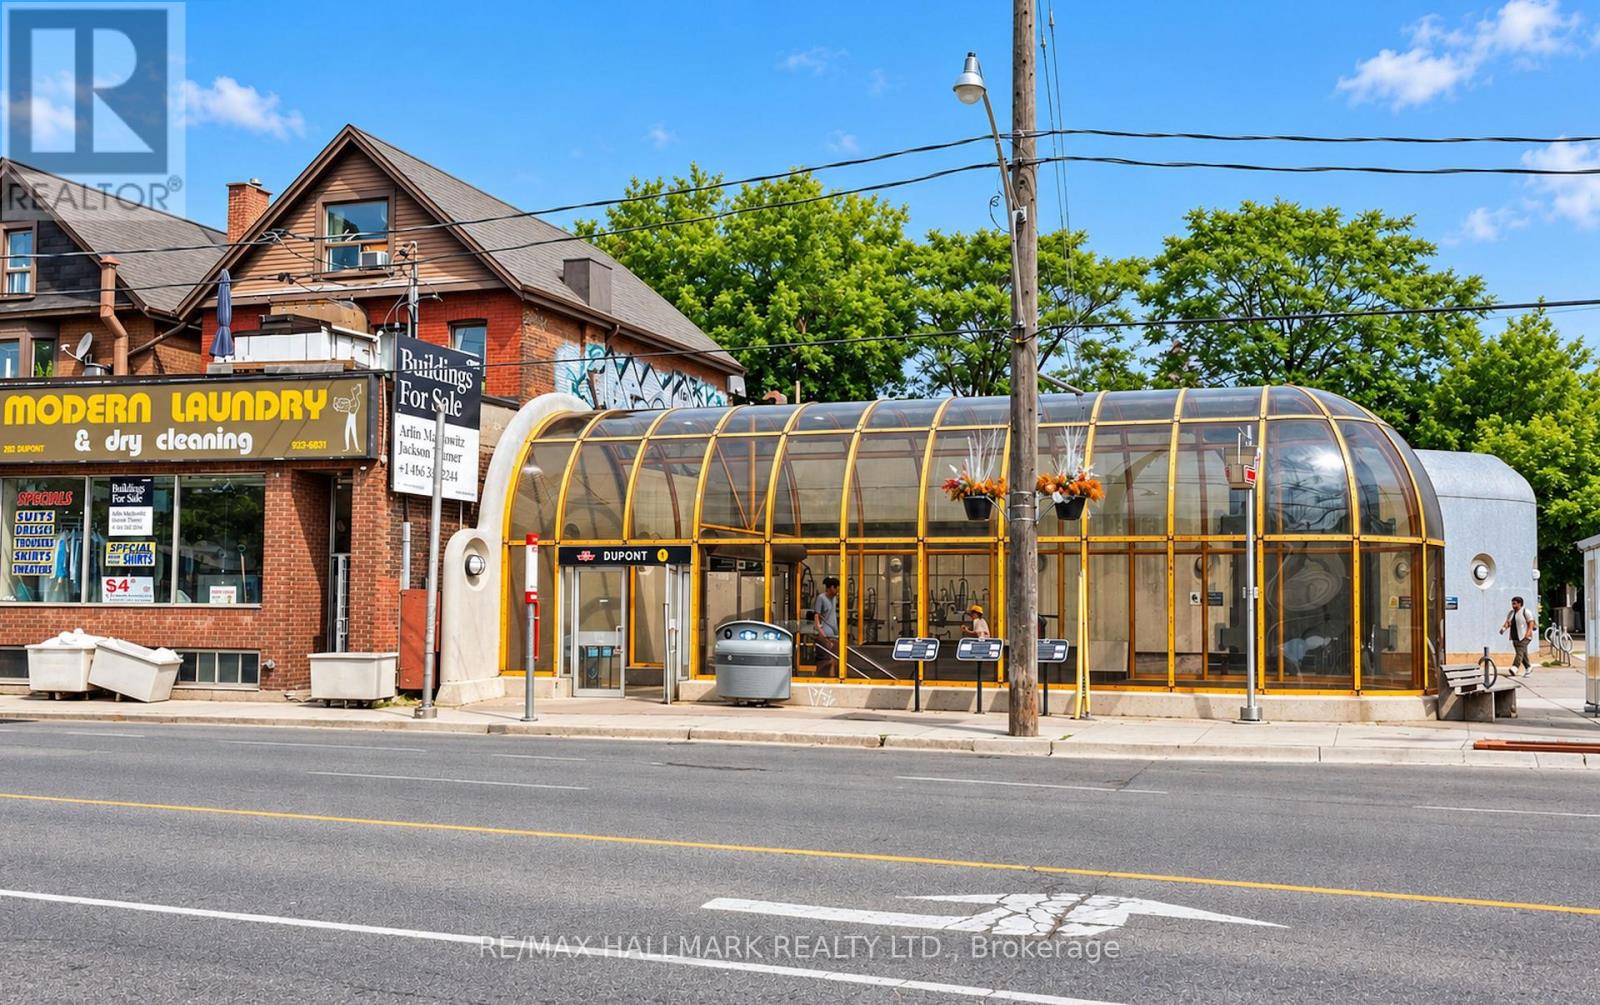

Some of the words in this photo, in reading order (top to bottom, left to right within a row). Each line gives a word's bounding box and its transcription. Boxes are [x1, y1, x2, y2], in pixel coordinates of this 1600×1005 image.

[400, 347, 473, 394] Buildings
[400, 379, 429, 409] For
[431, 387, 463, 417] Sale
[4, 392, 151, 425] MODERN
[171, 389, 328, 422] LAUNDRY
[399, 424, 422, 440] Arlin
[74, 429, 91, 451] &
[105, 429, 142, 457] dry
[156, 426, 253, 455] cleaning
[398, 440, 431, 459] Jackson
[112, 482, 146, 495] Buildings
[17, 490, 73, 506] SPECIALS
[112, 493, 126, 503] For
[126, 493, 144, 503] Sale
[18, 511, 53, 521] SUITS
[110, 543, 151, 553] SPECIAL
[14, 551, 51, 561] SKIRTS
[123, 553, 153, 565] SHIRTS
[603, 551, 648, 561] DUPONT
